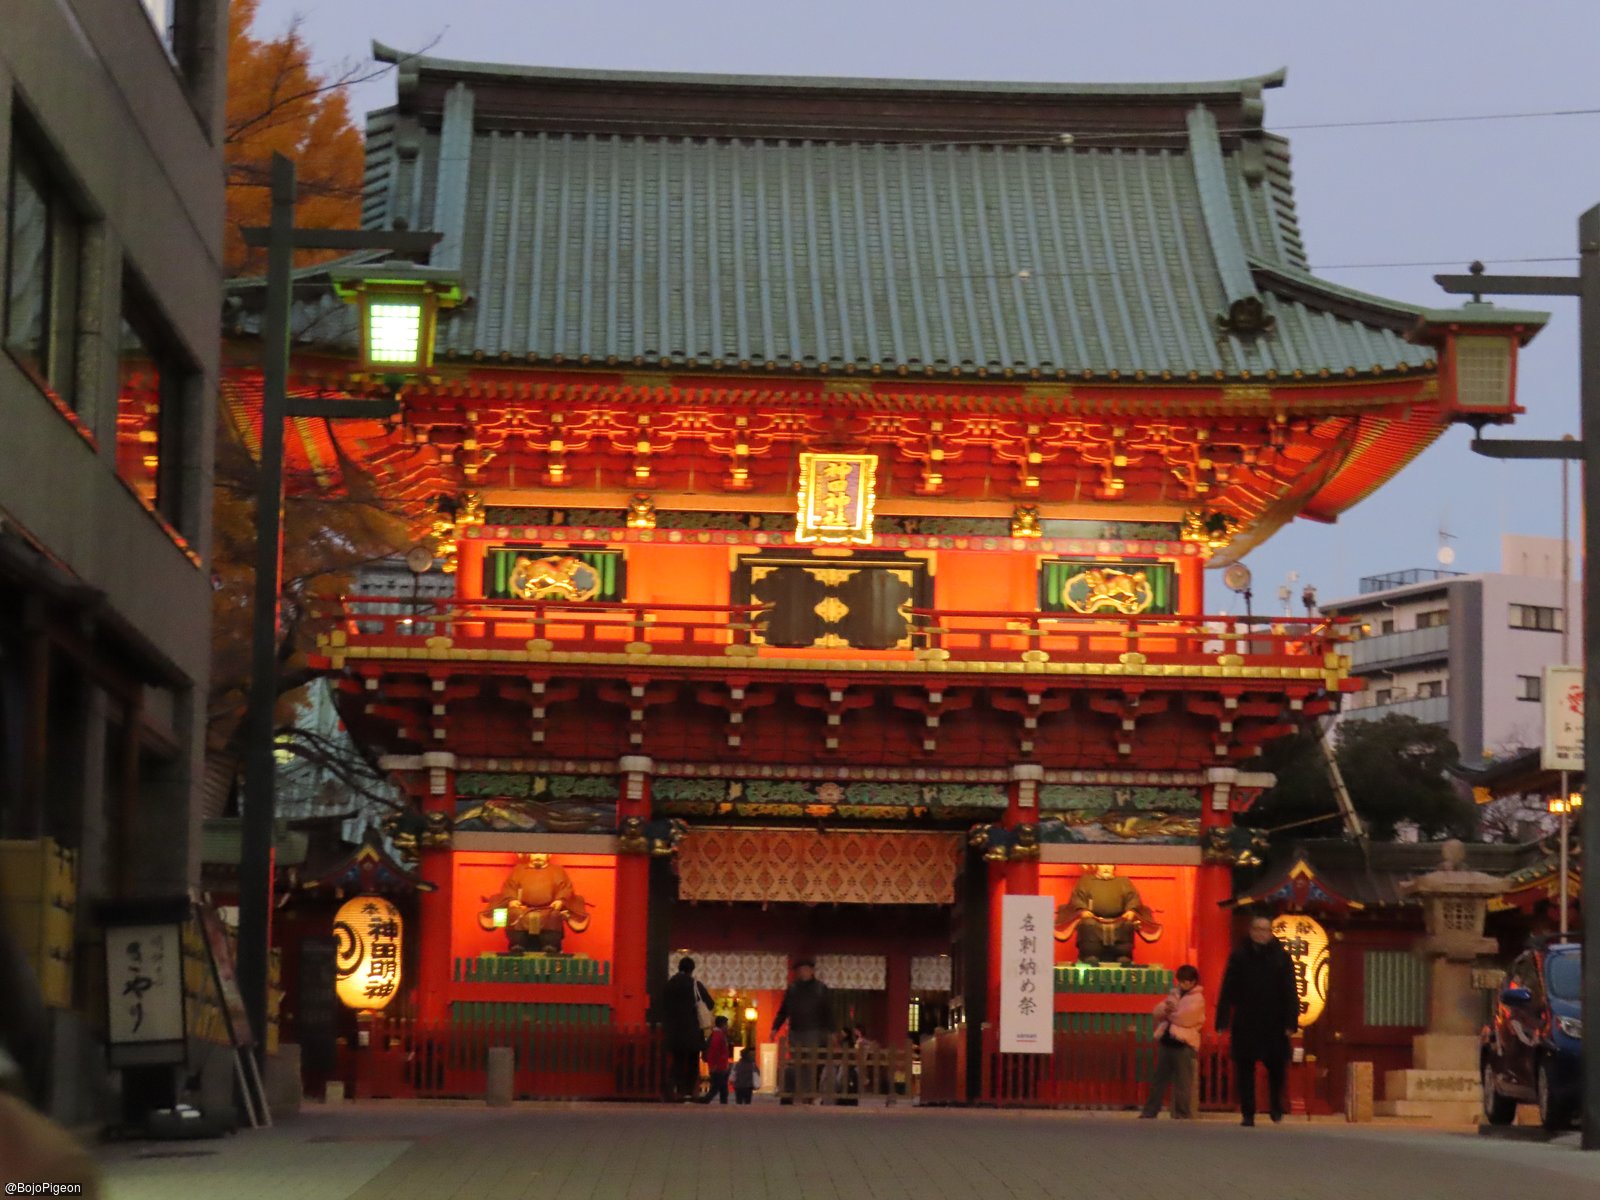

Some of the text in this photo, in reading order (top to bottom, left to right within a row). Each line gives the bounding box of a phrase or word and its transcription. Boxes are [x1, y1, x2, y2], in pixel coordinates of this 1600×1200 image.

[821, 461, 853, 527] 神田神社
[363, 917, 398, 999] 神田明神
[1018, 913, 1037, 1016] 名刺納め祭
